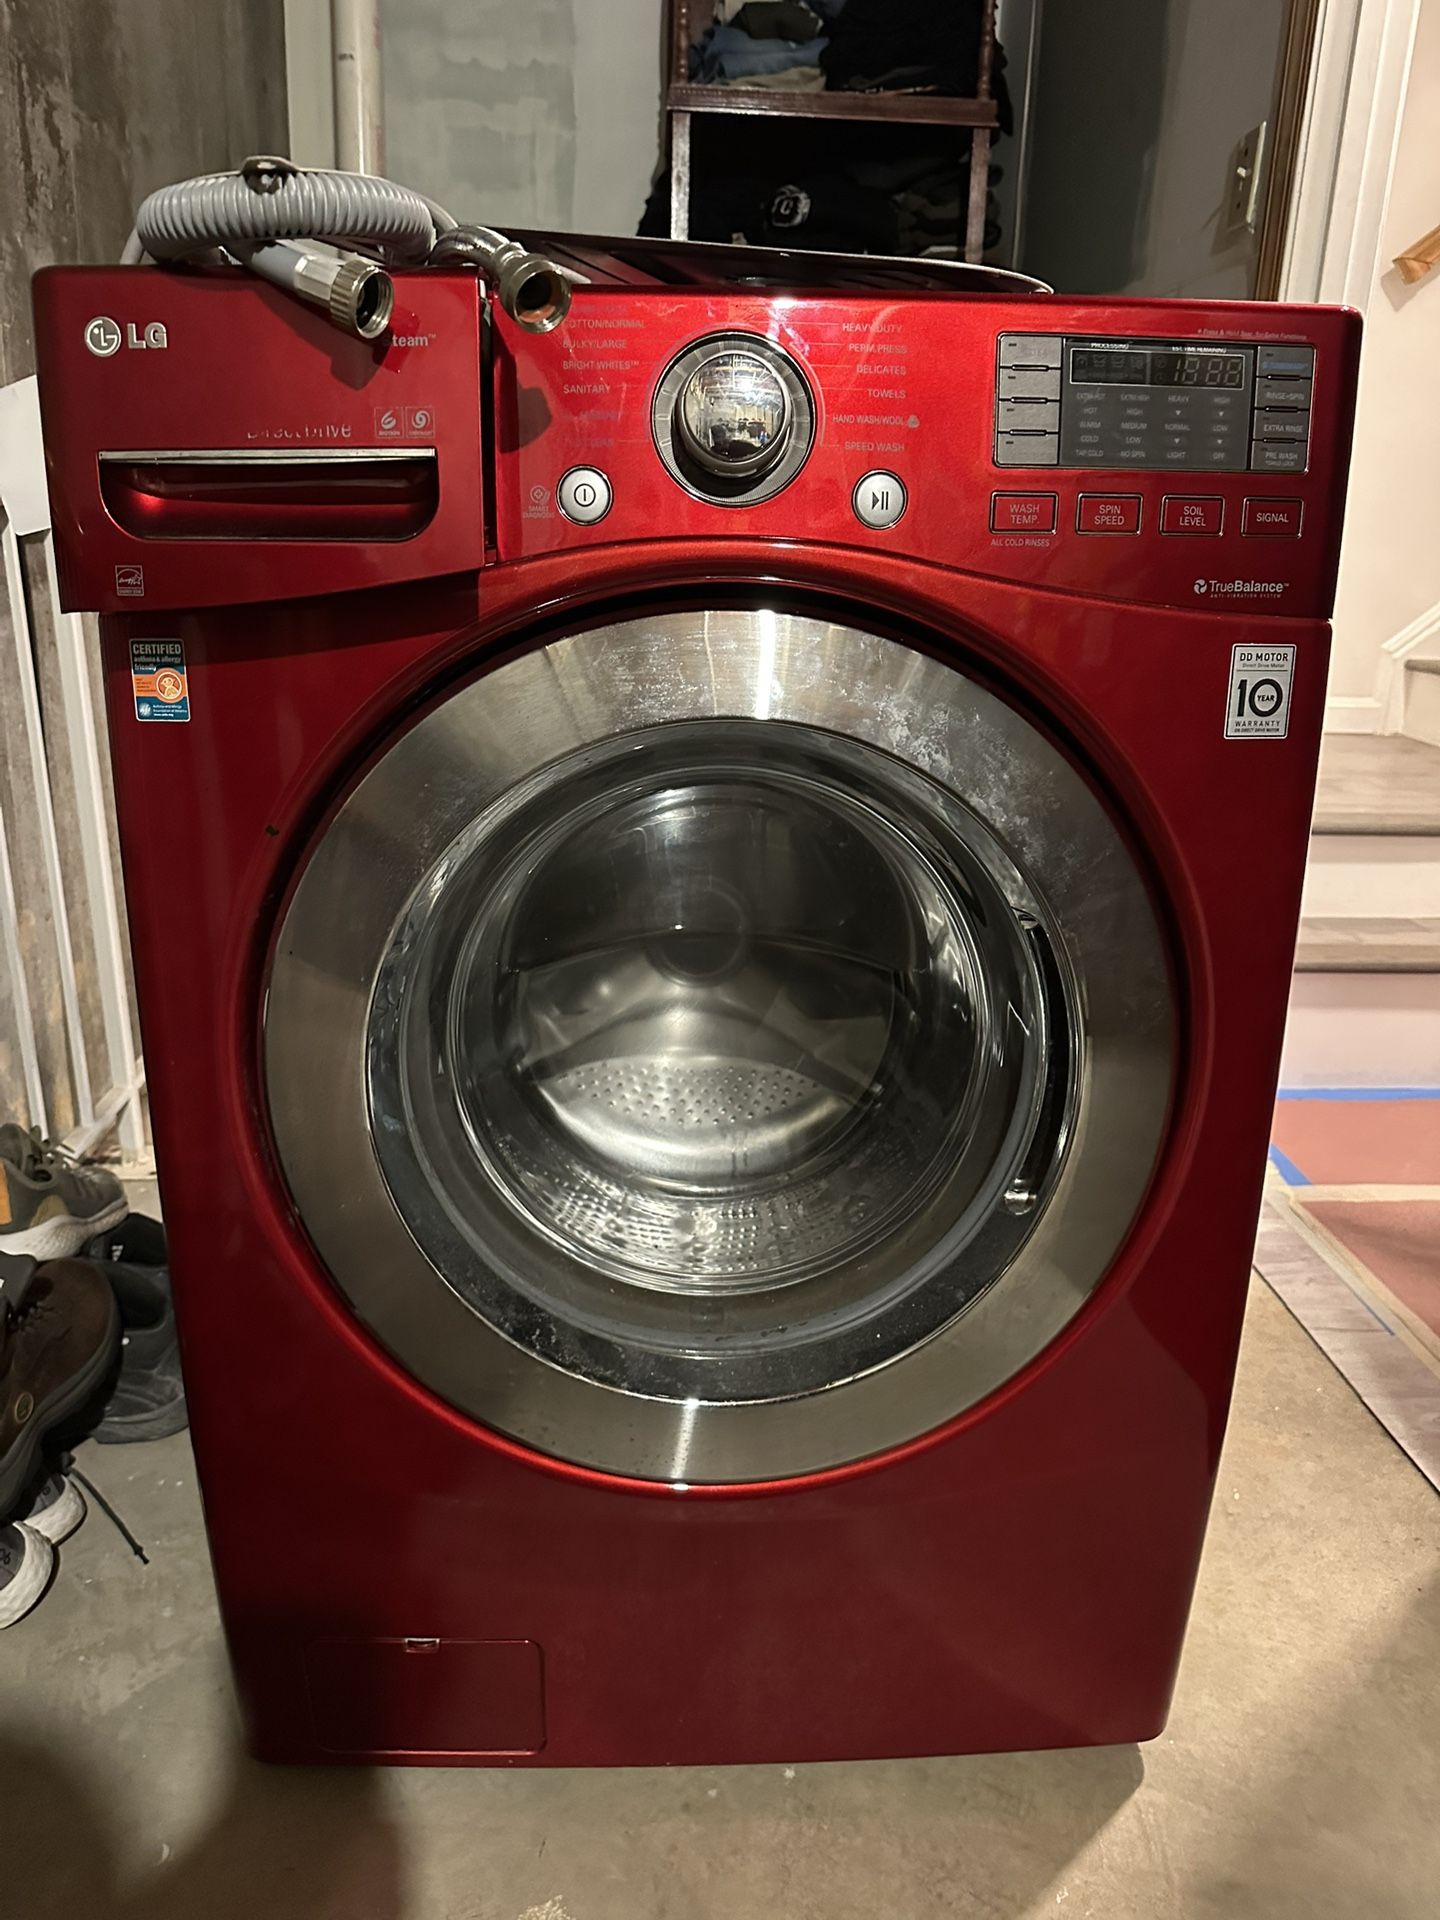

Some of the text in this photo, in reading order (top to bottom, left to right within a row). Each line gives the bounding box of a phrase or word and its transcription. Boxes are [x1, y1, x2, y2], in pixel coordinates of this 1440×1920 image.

[842, 322, 903, 334] HEAVY DUTY
[127, 322, 168, 349] LG
[562, 360, 595, 371] BRIGHT
[856, 364, 907, 376] DELICATES
[562, 383, 611, 395] SANITARY
[867, 388, 907, 399] TOWELS
[832, 414, 855, 424] HAND
[1121, 422, 1148, 430] MEDIUM
[1263, 424, 1285, 432] EXTRA
[1080, 434, 1099, 443] COLD
[1125, 436, 1142, 444] LOW
[844, 441, 905, 453] SPEED WASH
[1010, 504, 1040, 514] WASH
[1099, 504, 1121, 514] SPIN
[1183, 506, 1205, 516] SOIL
[1010, 515, 1039, 525] TEMP.
[1094, 516, 1125, 526] SPEED
[1179, 517, 1207, 527] LEVEL
[1256, 512, 1289, 523] SIGNAL
[990, 538, 1050, 548] ALL COLD RINSES
[132, 644, 182, 655] CERTIFIED
[1239, 652, 1289, 662] DD MOTOR
[1236, 678, 1284, 718] 10
[1257, 694, 1275, 702] YEAR
[1234, 720, 1281, 728] WARRANTY
